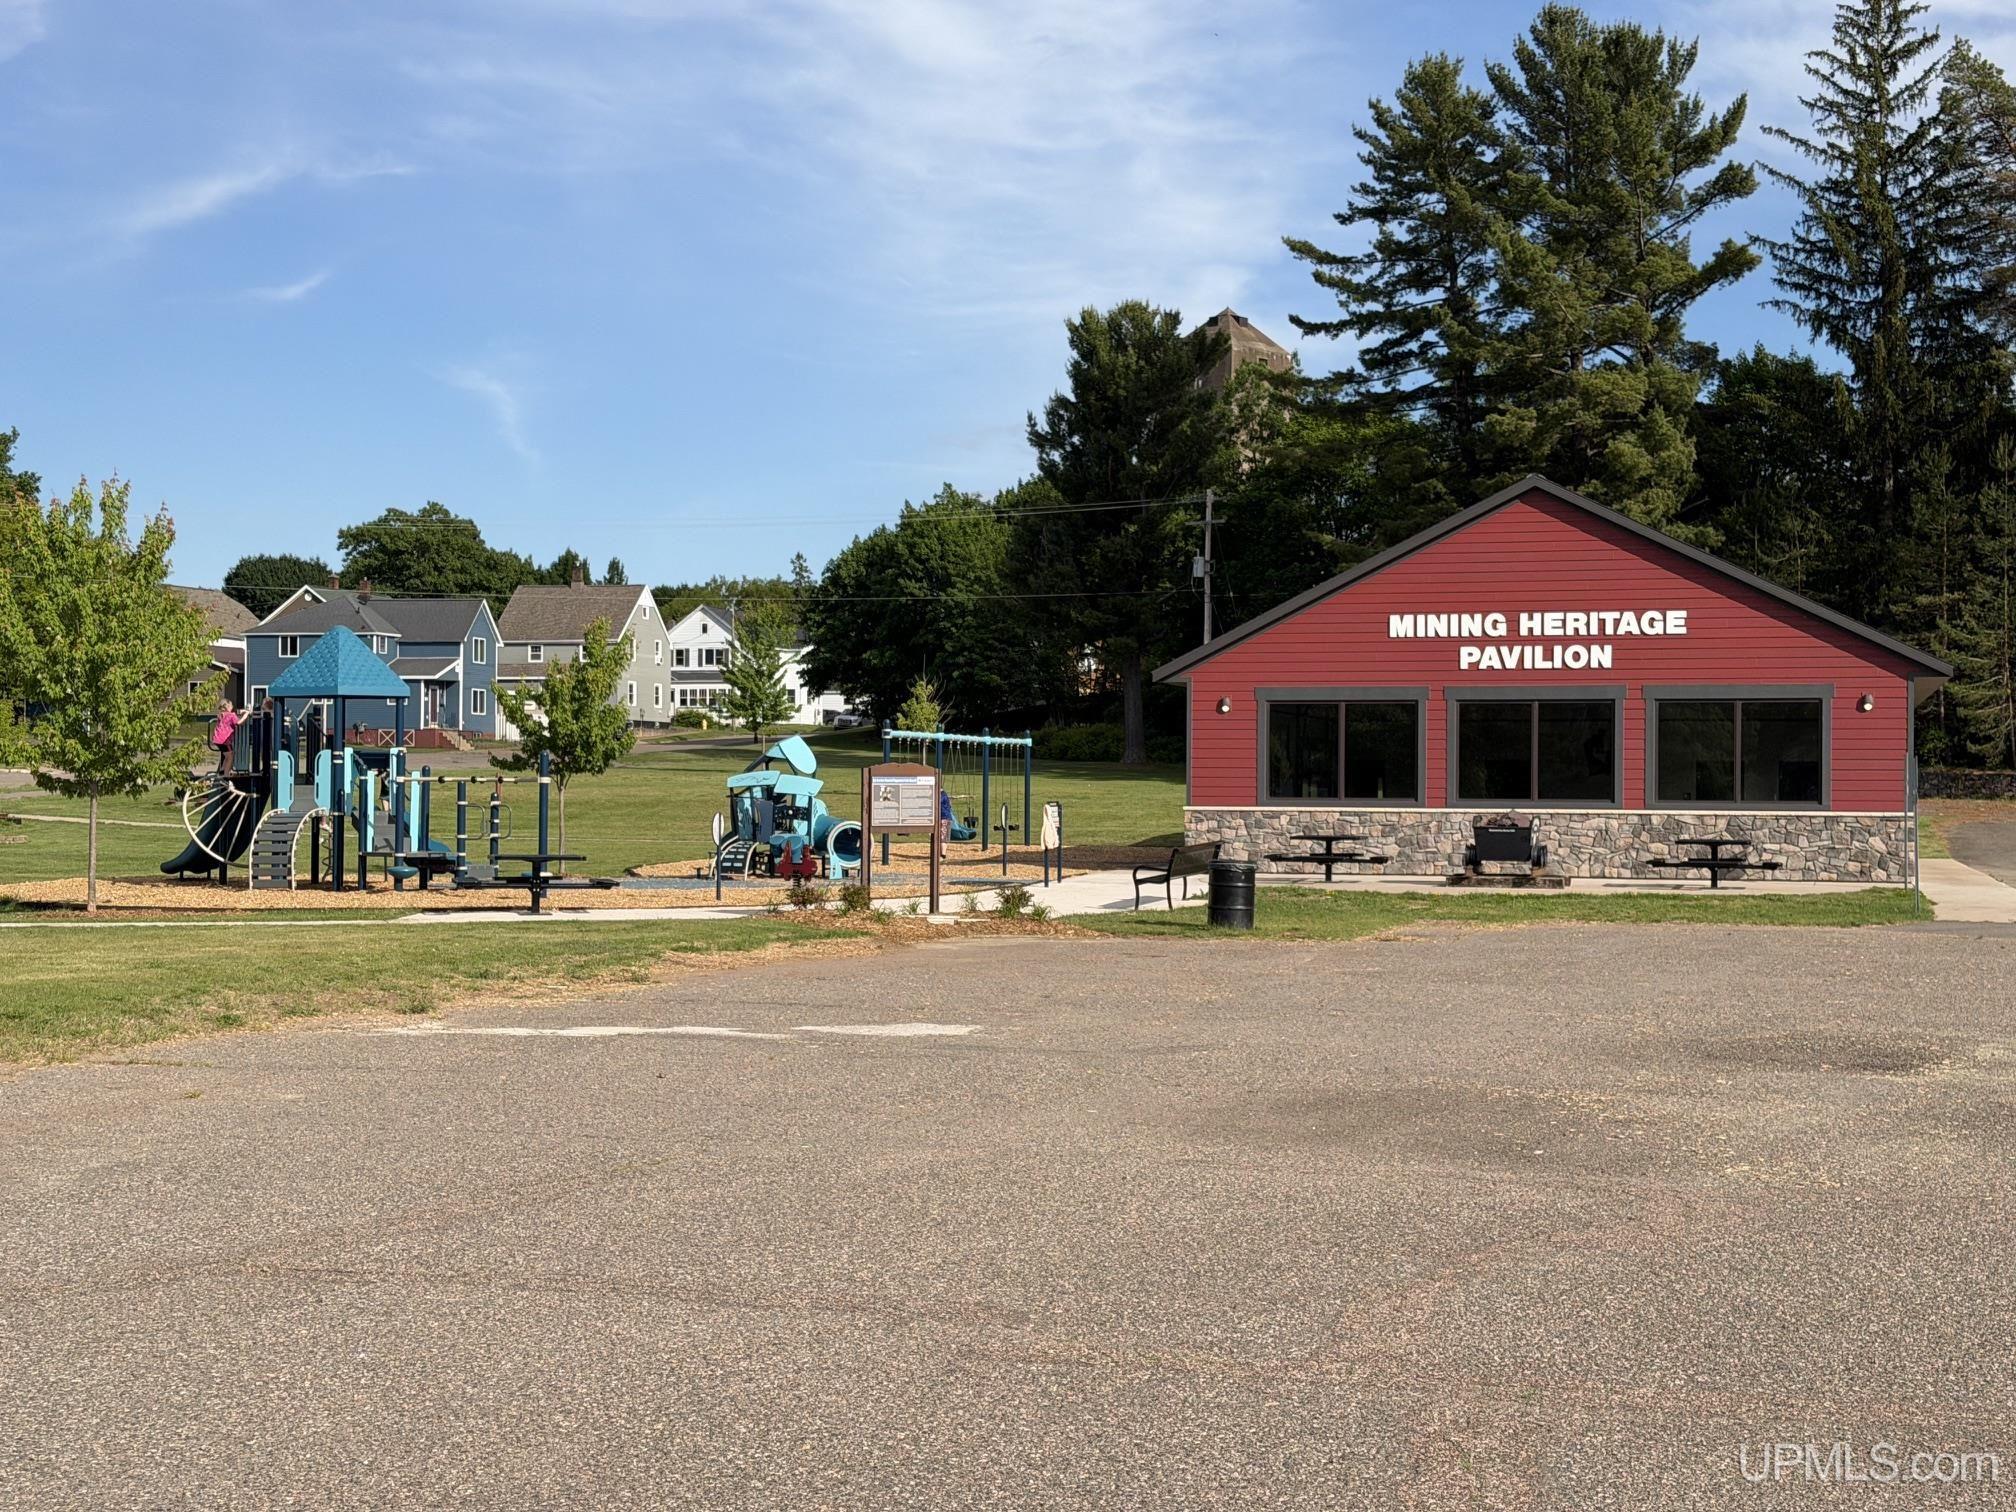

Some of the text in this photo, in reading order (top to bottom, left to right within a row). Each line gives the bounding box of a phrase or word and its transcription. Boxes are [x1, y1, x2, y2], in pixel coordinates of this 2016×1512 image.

[1388, 610, 1688, 638] MINING HERITAGE
[1459, 645, 1613, 670] PAVILION
